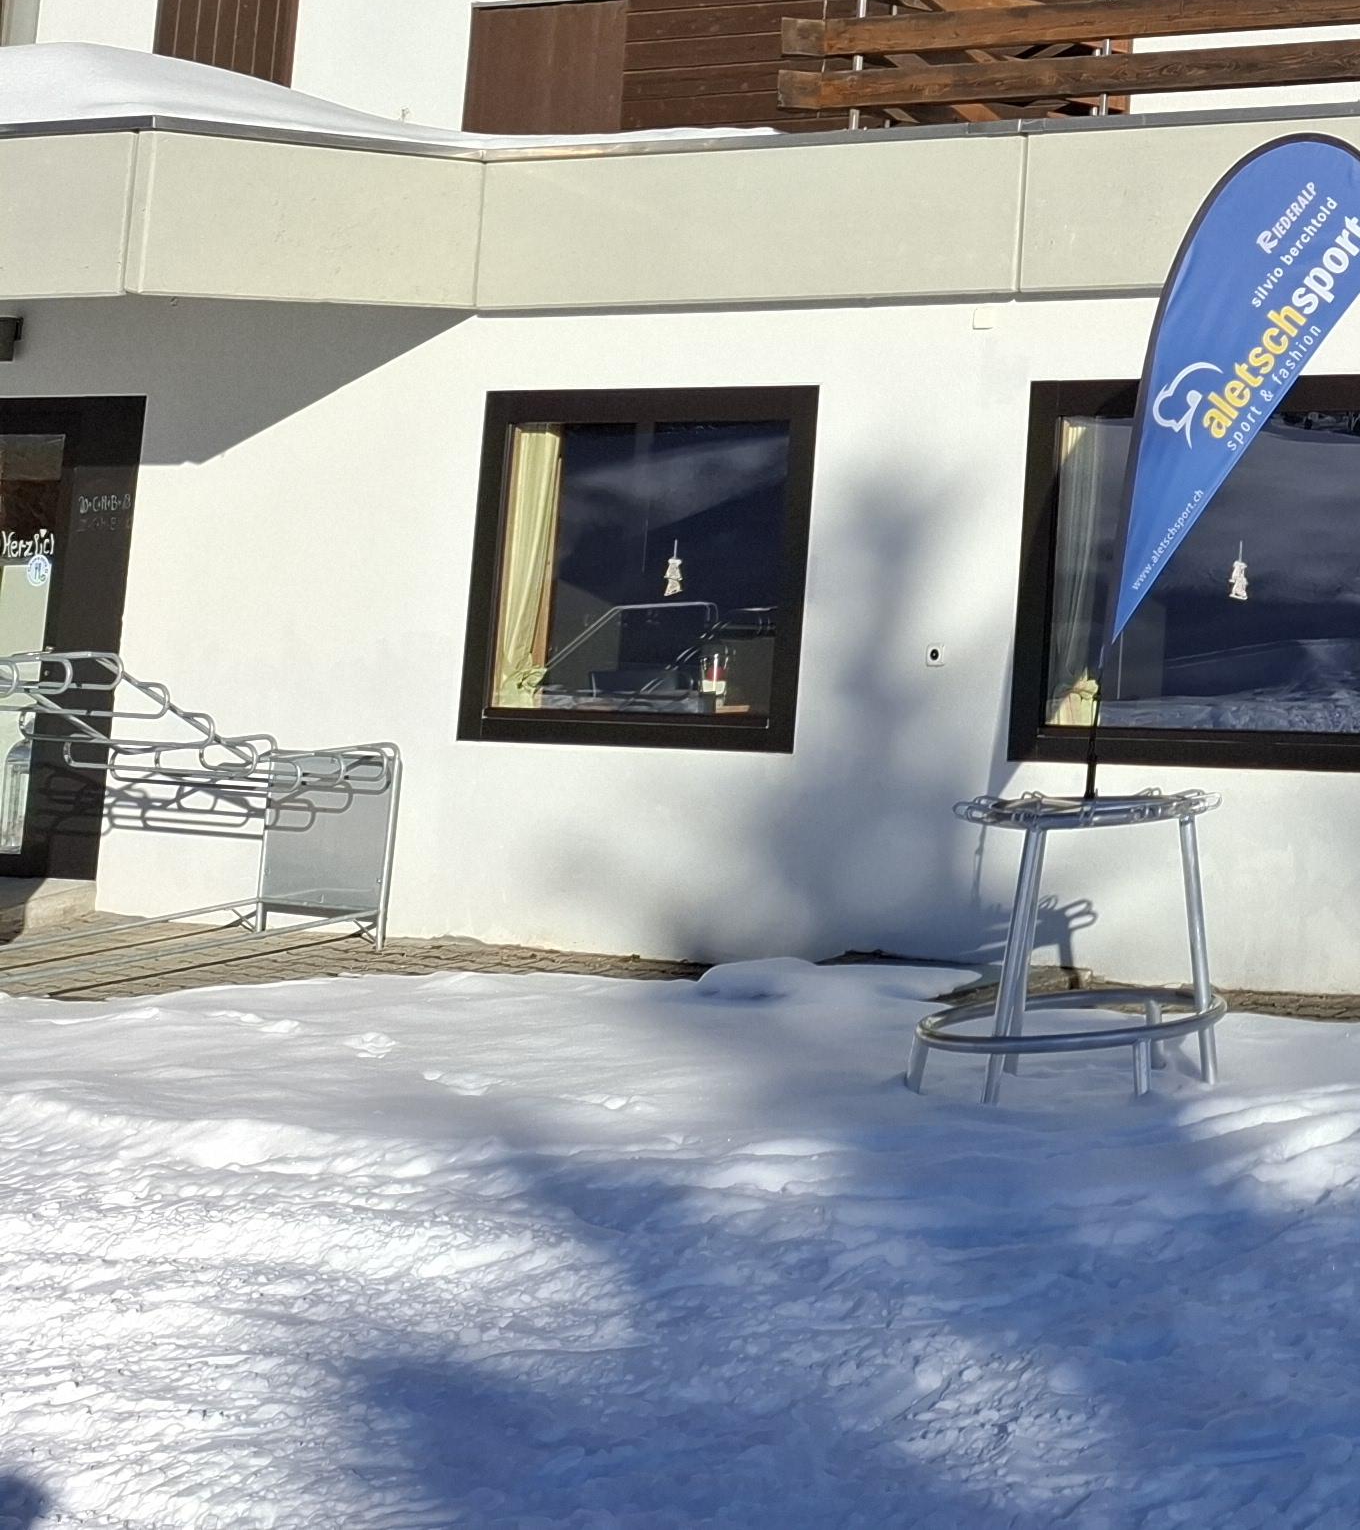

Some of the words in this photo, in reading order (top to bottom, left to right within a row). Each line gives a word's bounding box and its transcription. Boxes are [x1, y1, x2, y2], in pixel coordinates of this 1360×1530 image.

[1251, 267, 1284, 308] silvio
[1280, 196, 1338, 266] berchtold
[1256, 181, 1317, 254] RIEDERALP
[1227, 405, 1262, 451] sport
[1260, 389, 1275, 402] &
[1272, 325, 1322, 385] fashion
[1131, 489, 1204, 590] www.aletschsport.ch
